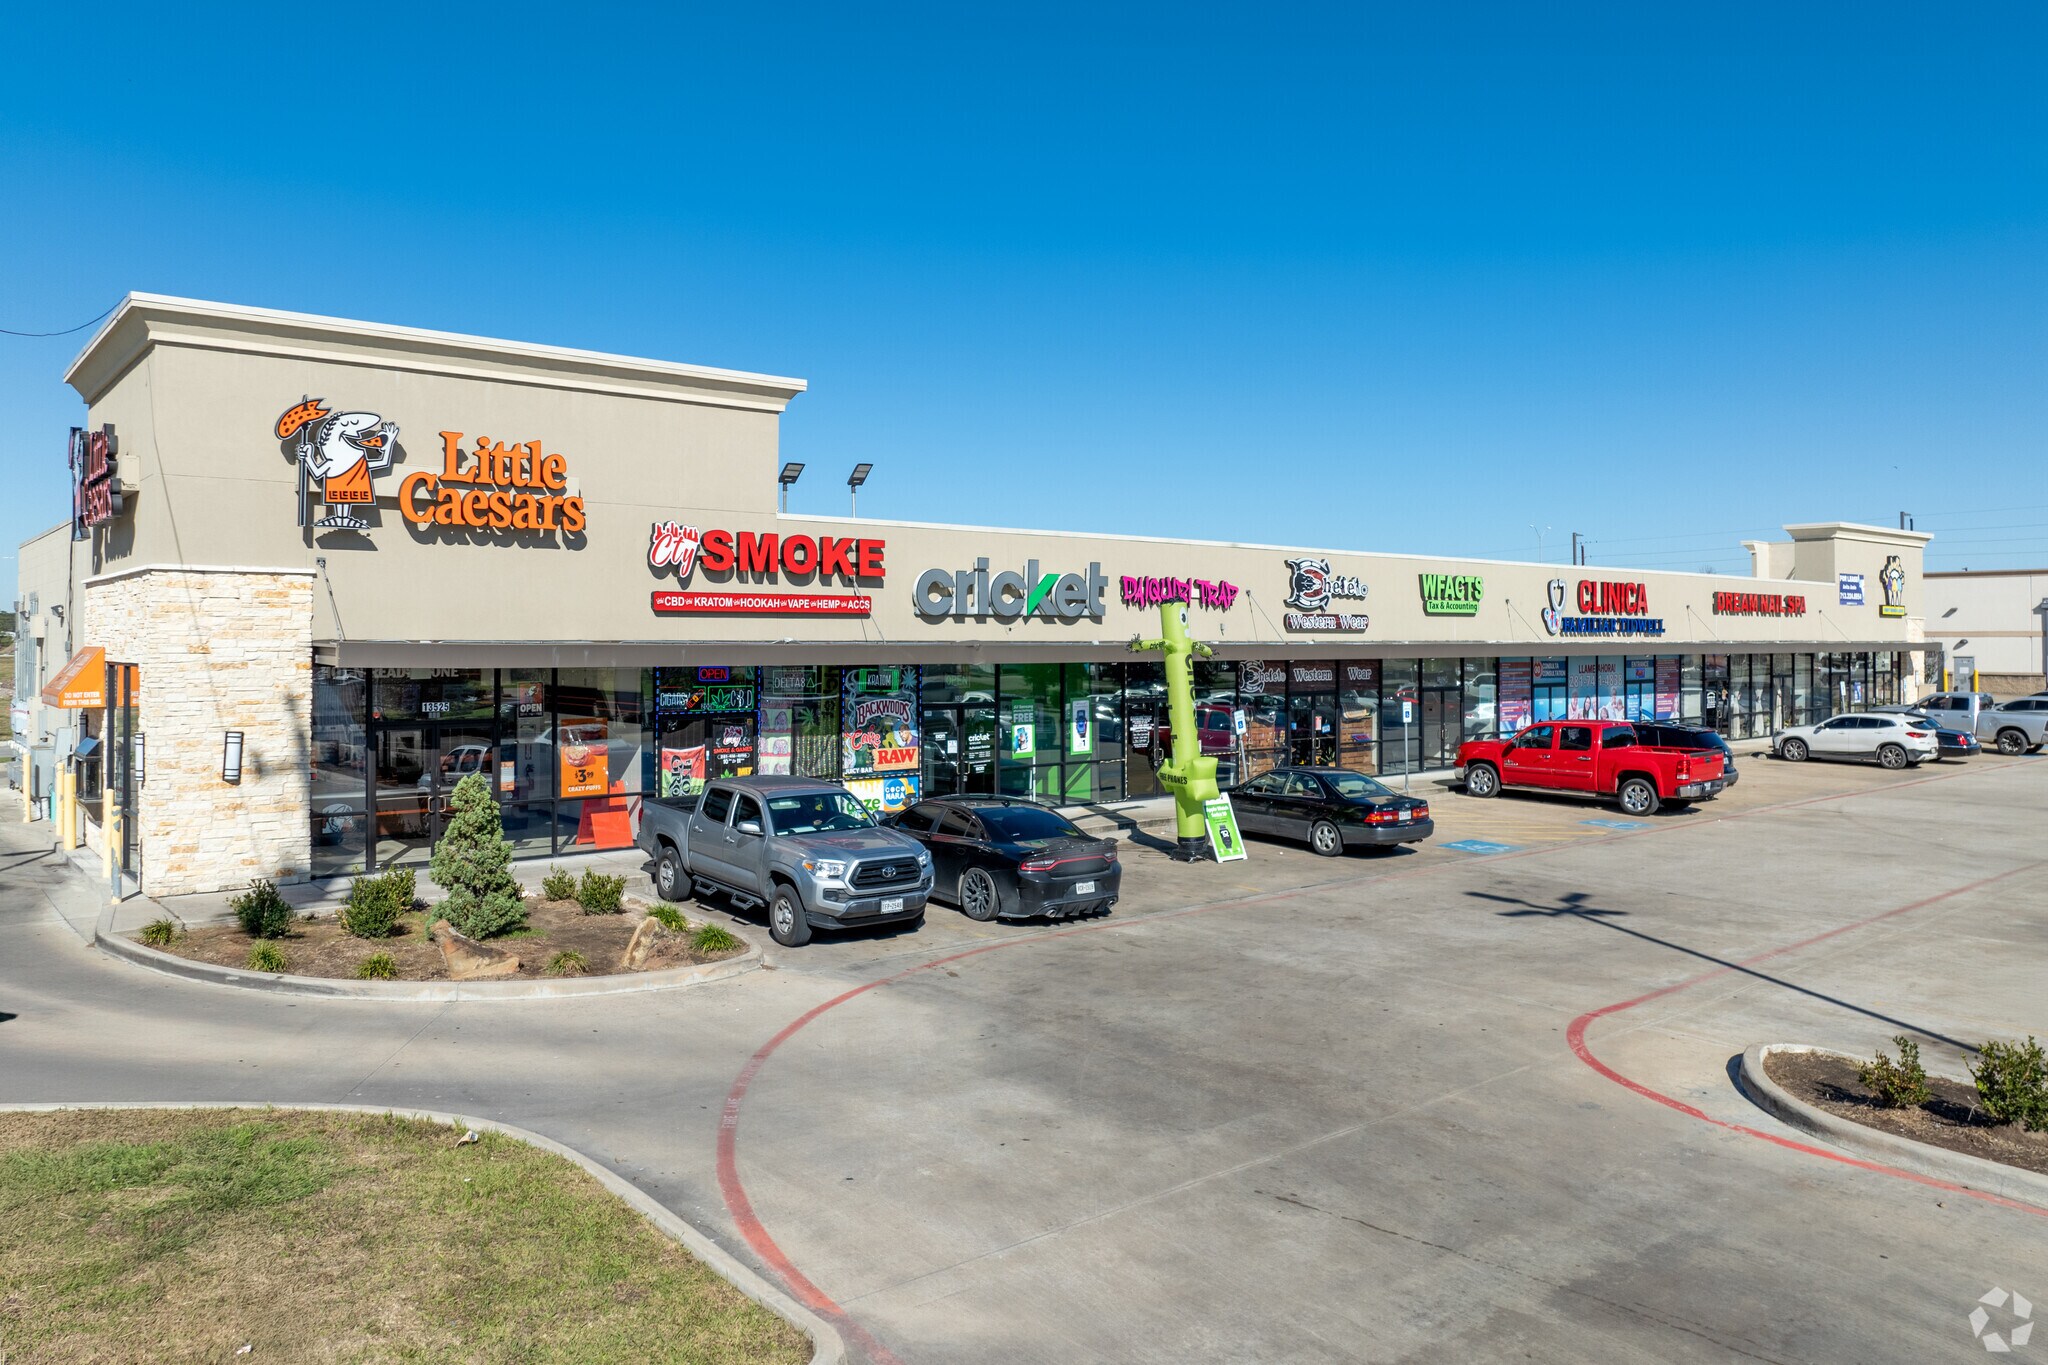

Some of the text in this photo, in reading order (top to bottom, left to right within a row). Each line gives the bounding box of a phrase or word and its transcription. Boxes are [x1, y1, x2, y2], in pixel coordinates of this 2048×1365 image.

[438, 430, 567, 490] Little
[399, 471, 586, 532] Caesars
[701, 529, 886, 577] SMOKE
[914, 557, 1109, 617] cricket
[1195, 579, 1239, 609] TRAP
[1421, 574, 1484, 600] WFACTS
[664, 596, 870, 610] CBD KRATOM HOOKAH VAPE HEMP ACCS
[1578, 579, 1648, 614] CLINICA
[1717, 591, 1807, 614] DREAM NAIL SPA
[1428, 602, 1439, 610] Tax
[1446, 602, 1478, 612] Accounting
[1289, 613, 1369, 629] Western Wear
[1562, 617, 1618, 633] FAMILIAR
[700, 668, 727, 679] OPEN
[1293, 667, 1372, 682] Western Wear
[1578, 664, 1596, 674] LLAME
[774, 677, 806, 688] DELTA8
[867, 673, 892, 686] KRATOM
[945, 675, 968, 686] OPEN
[730, 690, 753, 707] CBD
[422, 702, 450, 712] 13525
[519, 703, 543, 713] OPEN
[856, 699, 912, 728] BACKWOODS
[1013, 713, 1034, 722] FREE
[968, 733, 990, 742] cricket
[877, 749, 917, 765] RAW
